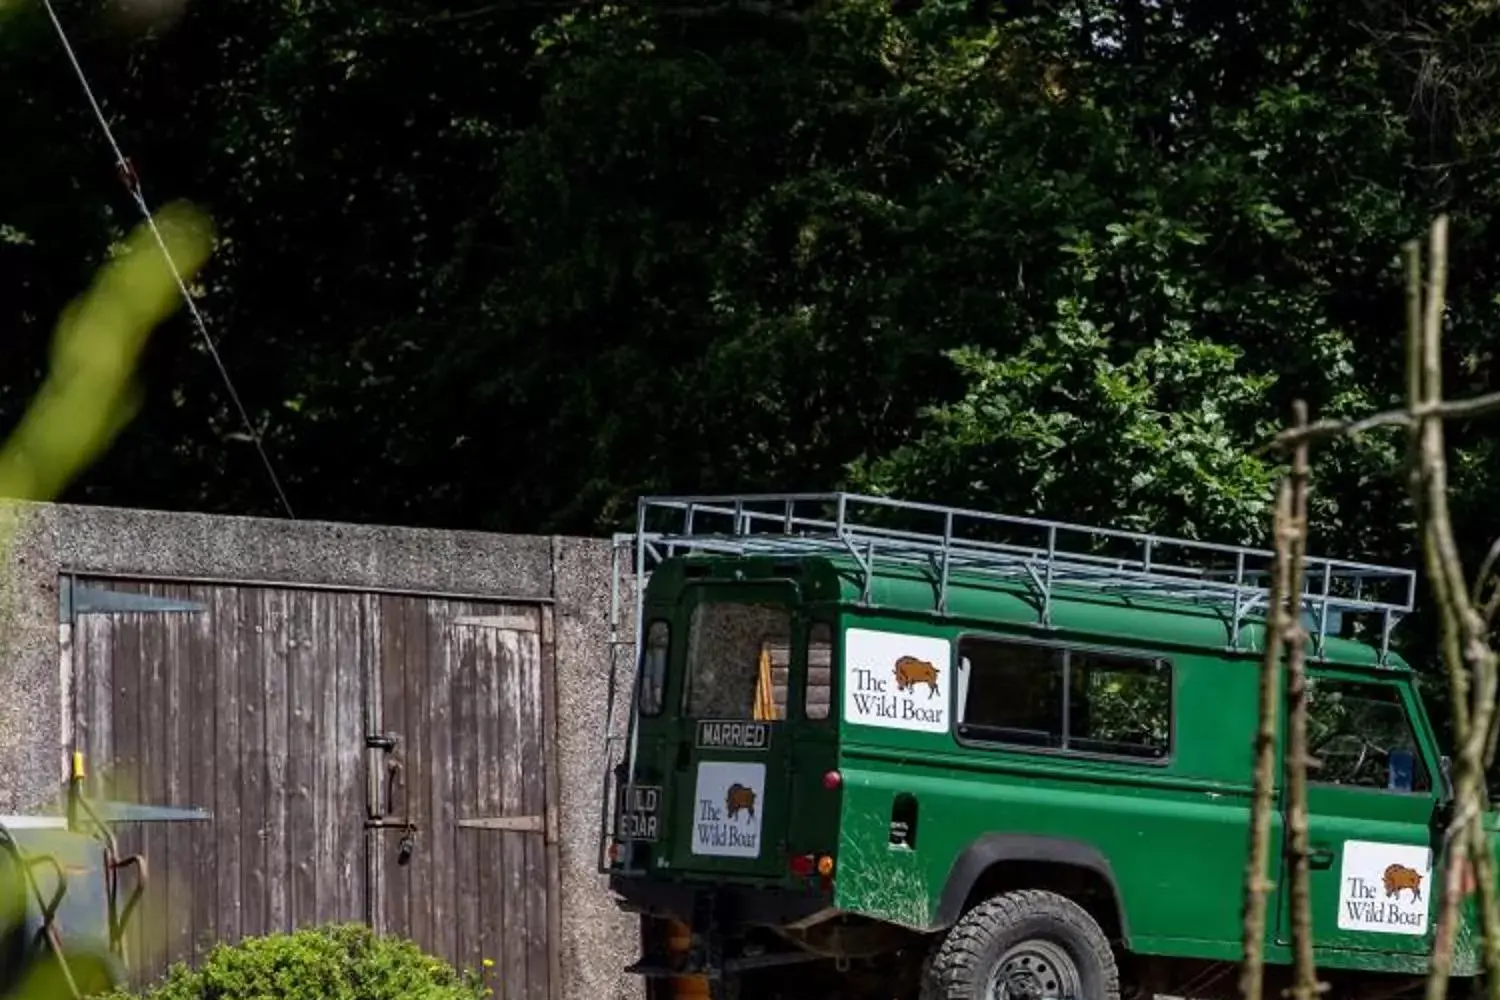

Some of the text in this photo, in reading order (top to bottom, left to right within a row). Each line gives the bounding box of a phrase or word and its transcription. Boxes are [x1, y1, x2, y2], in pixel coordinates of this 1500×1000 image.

[852, 668, 887, 693] The
[852, 693, 943, 723] Wild Boar
[703, 723, 765, 747] MARRIED
[699, 799, 722, 821] The
[697, 822, 757, 849] Wild Boar
[1347, 877, 1377, 899] The
[1346, 901, 1425, 926] Wild Boar
